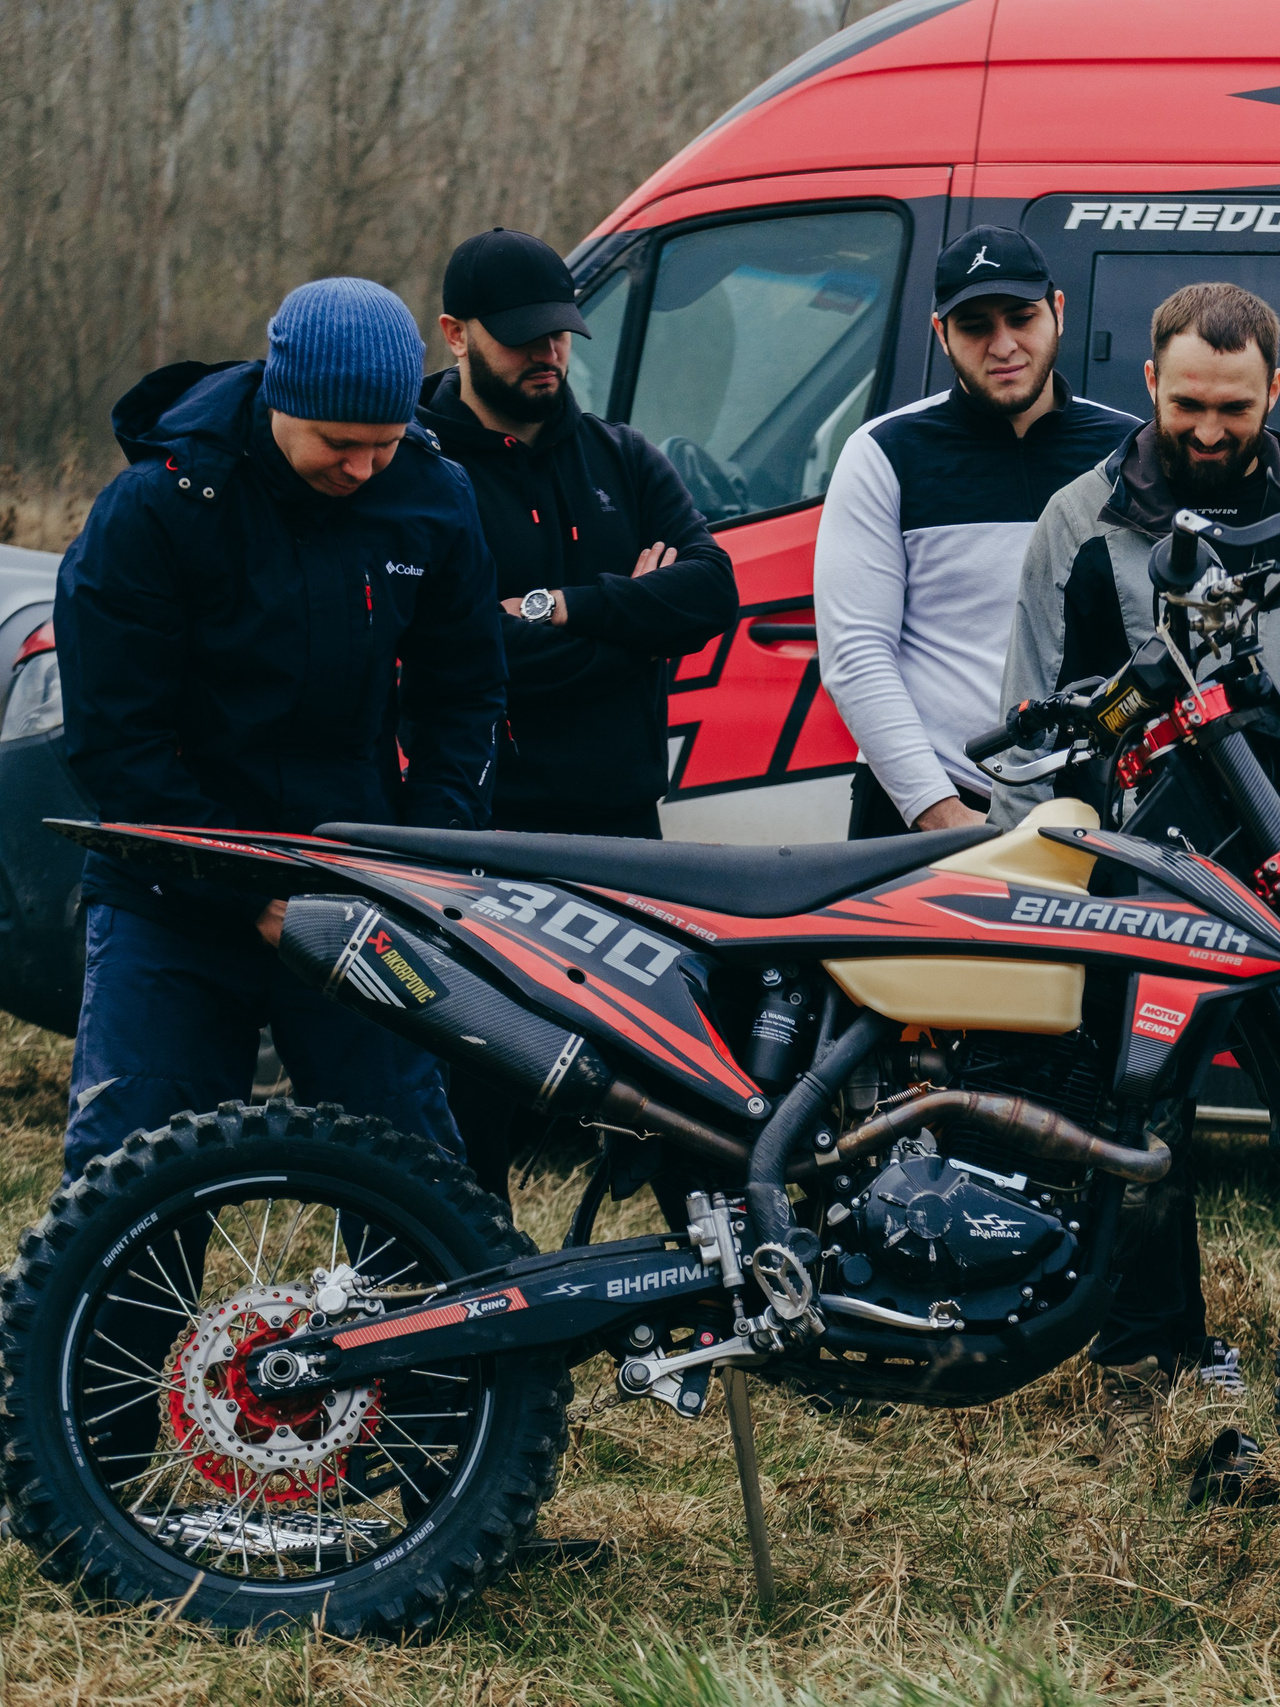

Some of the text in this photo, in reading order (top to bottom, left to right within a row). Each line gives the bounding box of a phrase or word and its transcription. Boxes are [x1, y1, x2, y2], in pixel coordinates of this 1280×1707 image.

[214, 841, 269, 855] ATHENA
[470, 903, 507, 921] AIR
[625, 897, 718, 942] EXPERT PRO
[476, 881, 682, 986] 300
[1011, 896, 1251, 954] SHARMAX
[1188, 949, 1243, 966] MOTORS
[768, 1012, 796, 1026] WARNING
[1143, 1006, 1180, 1023] MOTUL
[1135, 1019, 1176, 1038] KENDA
[102, 1212, 159, 1268] GIANT RACE
[969, 1229, 1021, 1239] SHARMAX
[373, 1520, 435, 1571] GIANT RACE
